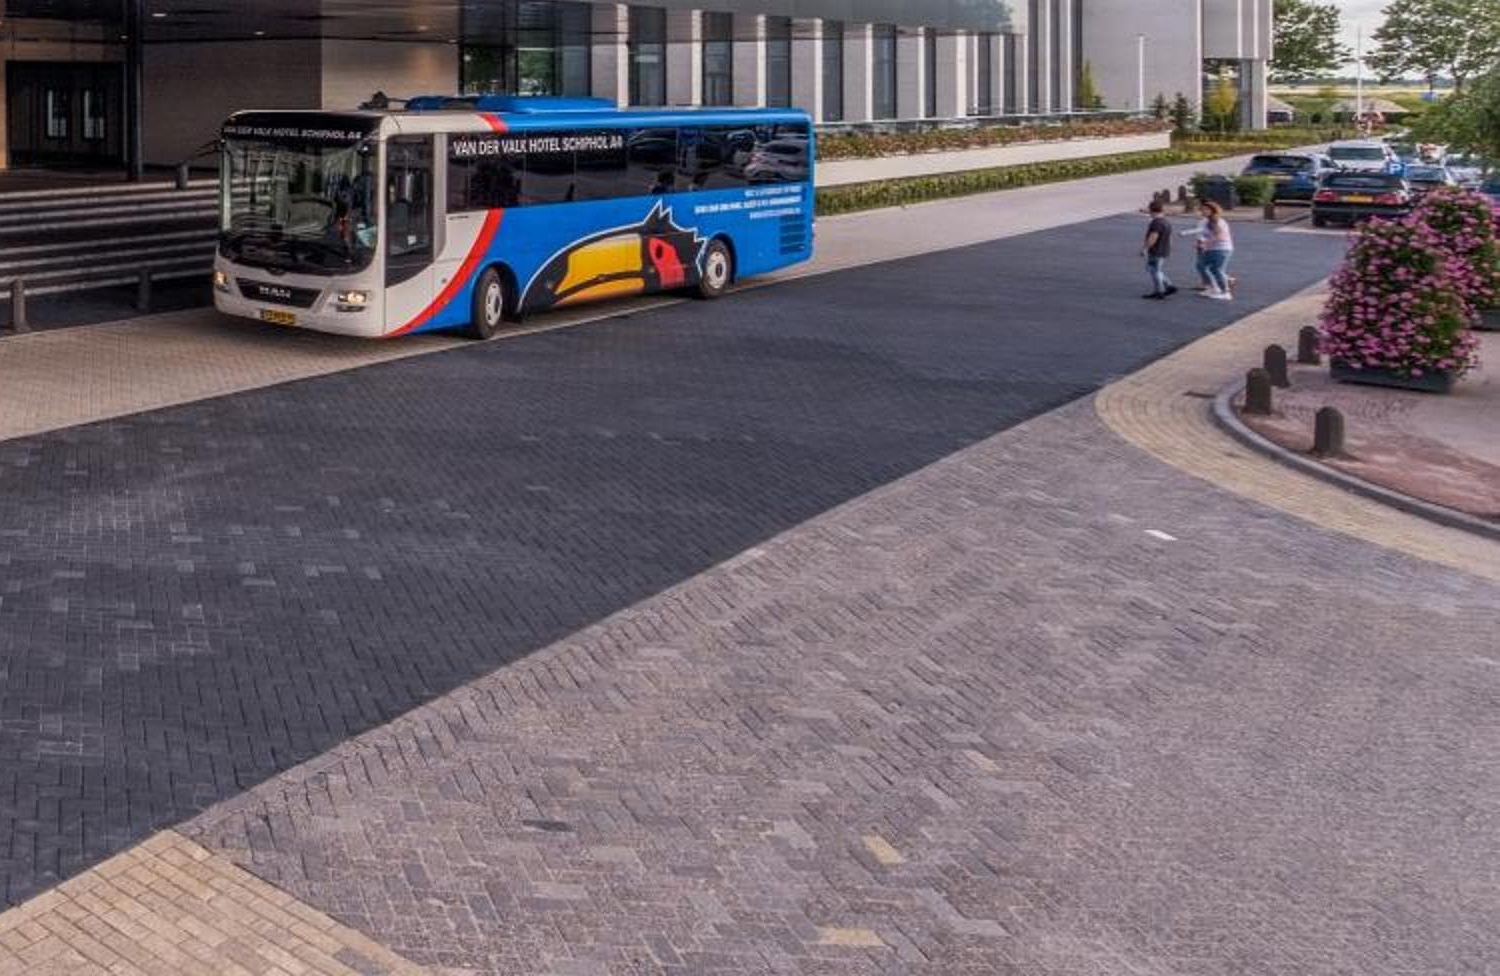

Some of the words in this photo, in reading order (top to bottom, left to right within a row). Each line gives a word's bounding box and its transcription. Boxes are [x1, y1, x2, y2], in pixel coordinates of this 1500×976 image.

[453, 140, 477, 157] VAN
[478, 140, 500, 155] DER
[501, 138, 527, 154] VALK
[529, 137, 561, 153] HOTEL
[562, 136, 609, 152] SCHIPHOL
[1389, 163, 1401, 175] P
